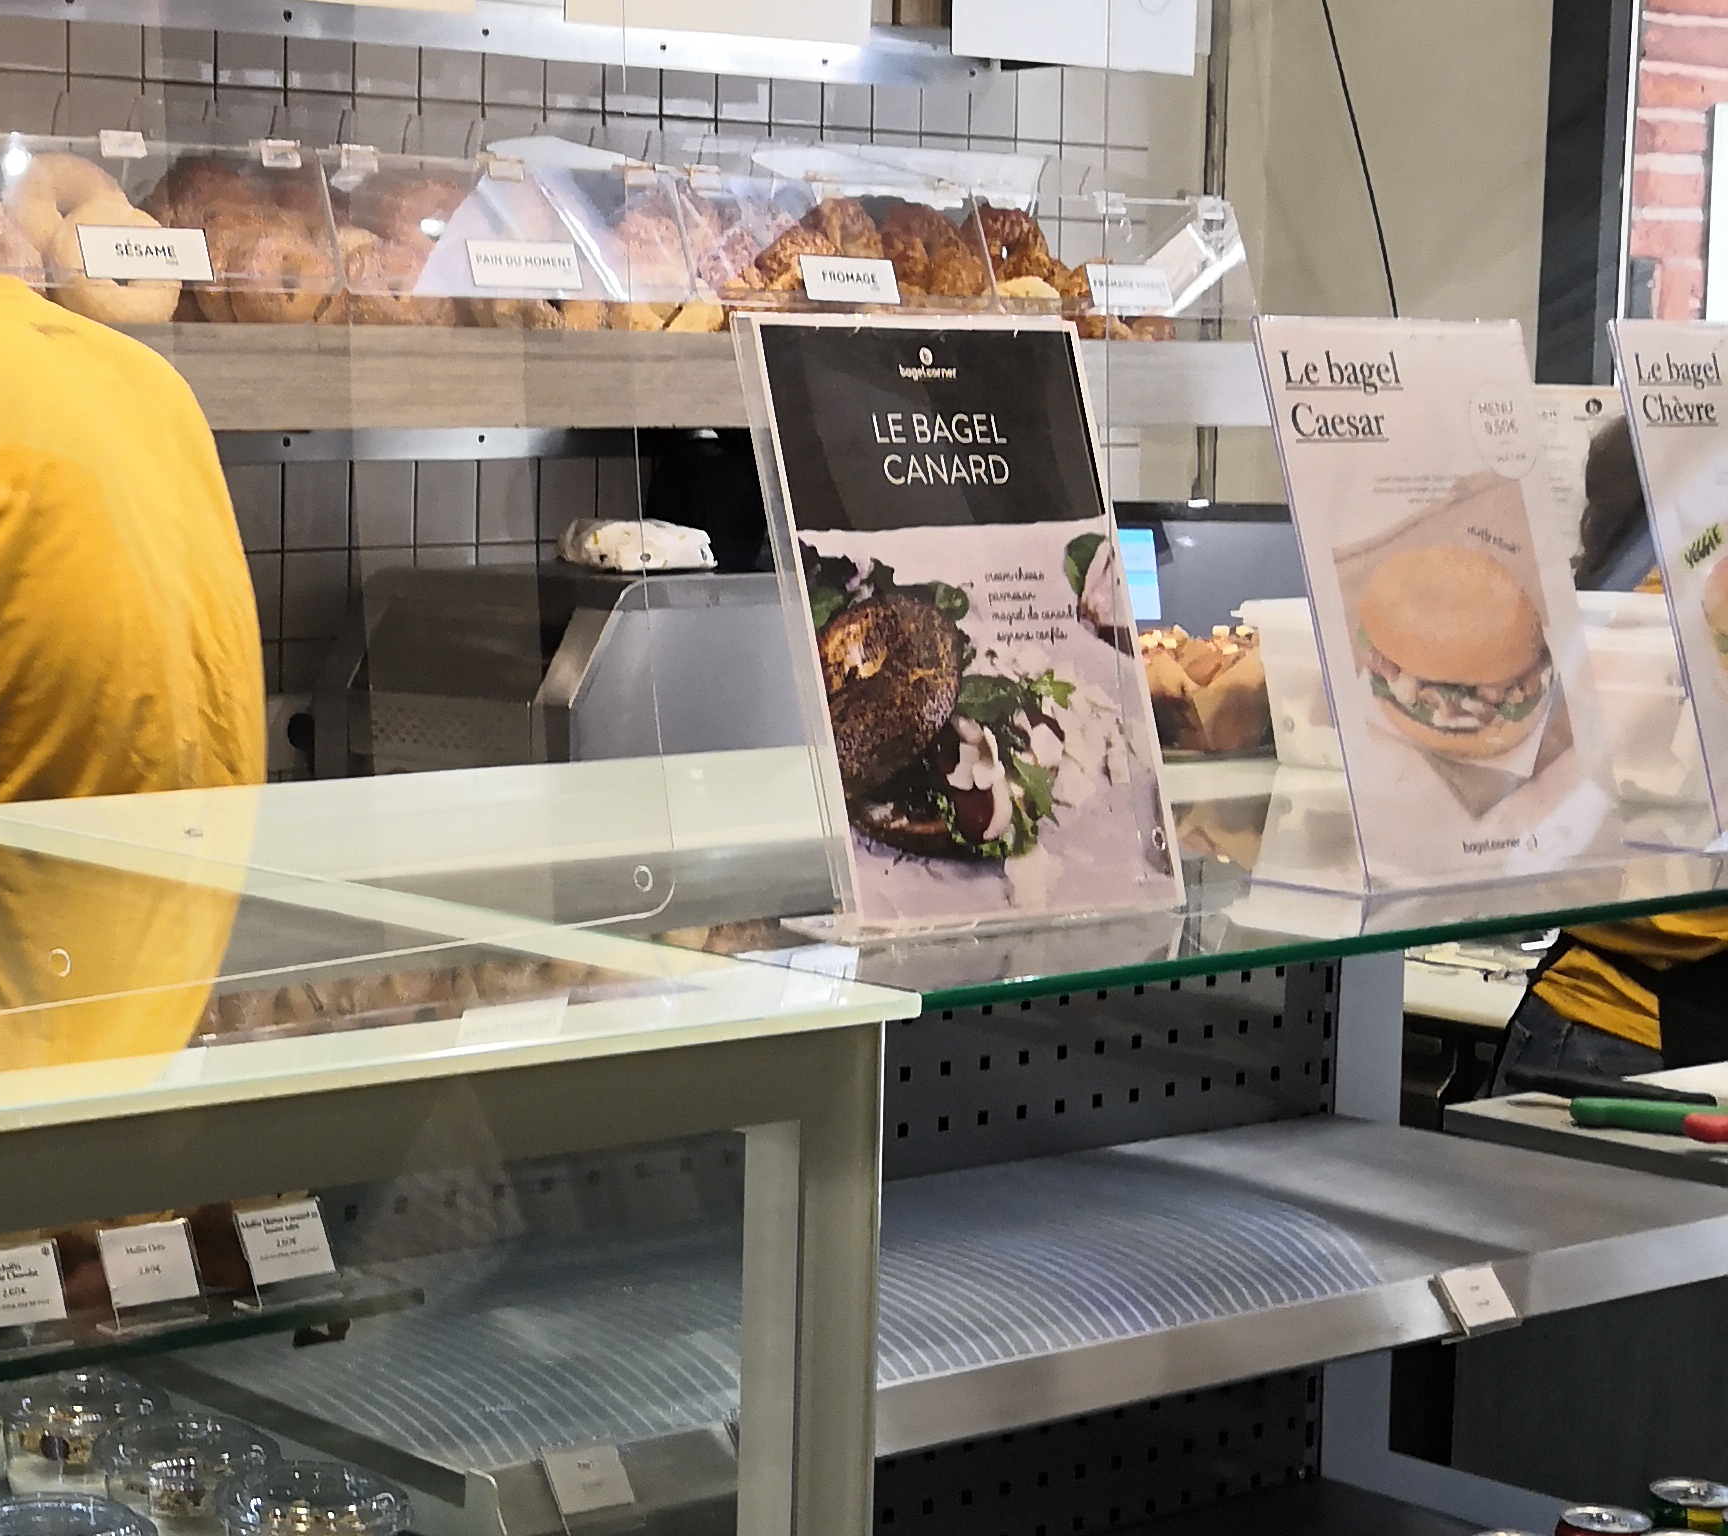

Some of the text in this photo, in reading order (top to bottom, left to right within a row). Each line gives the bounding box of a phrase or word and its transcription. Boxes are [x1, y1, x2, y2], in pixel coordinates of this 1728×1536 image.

[113, 238, 178, 261] SÉSAME
[821, 268, 878, 287] FROMAGE
[1279, 348, 1402, 394] Le bagel
[1633, 350, 1723, 390] Le bagel
[1290, 402, 1386, 440] Caesar
[1641, 392, 1718, 424] Chèvre
[871, 412, 1008, 445] LE BAGEL
[882, 453, 1011, 486] CANARD
